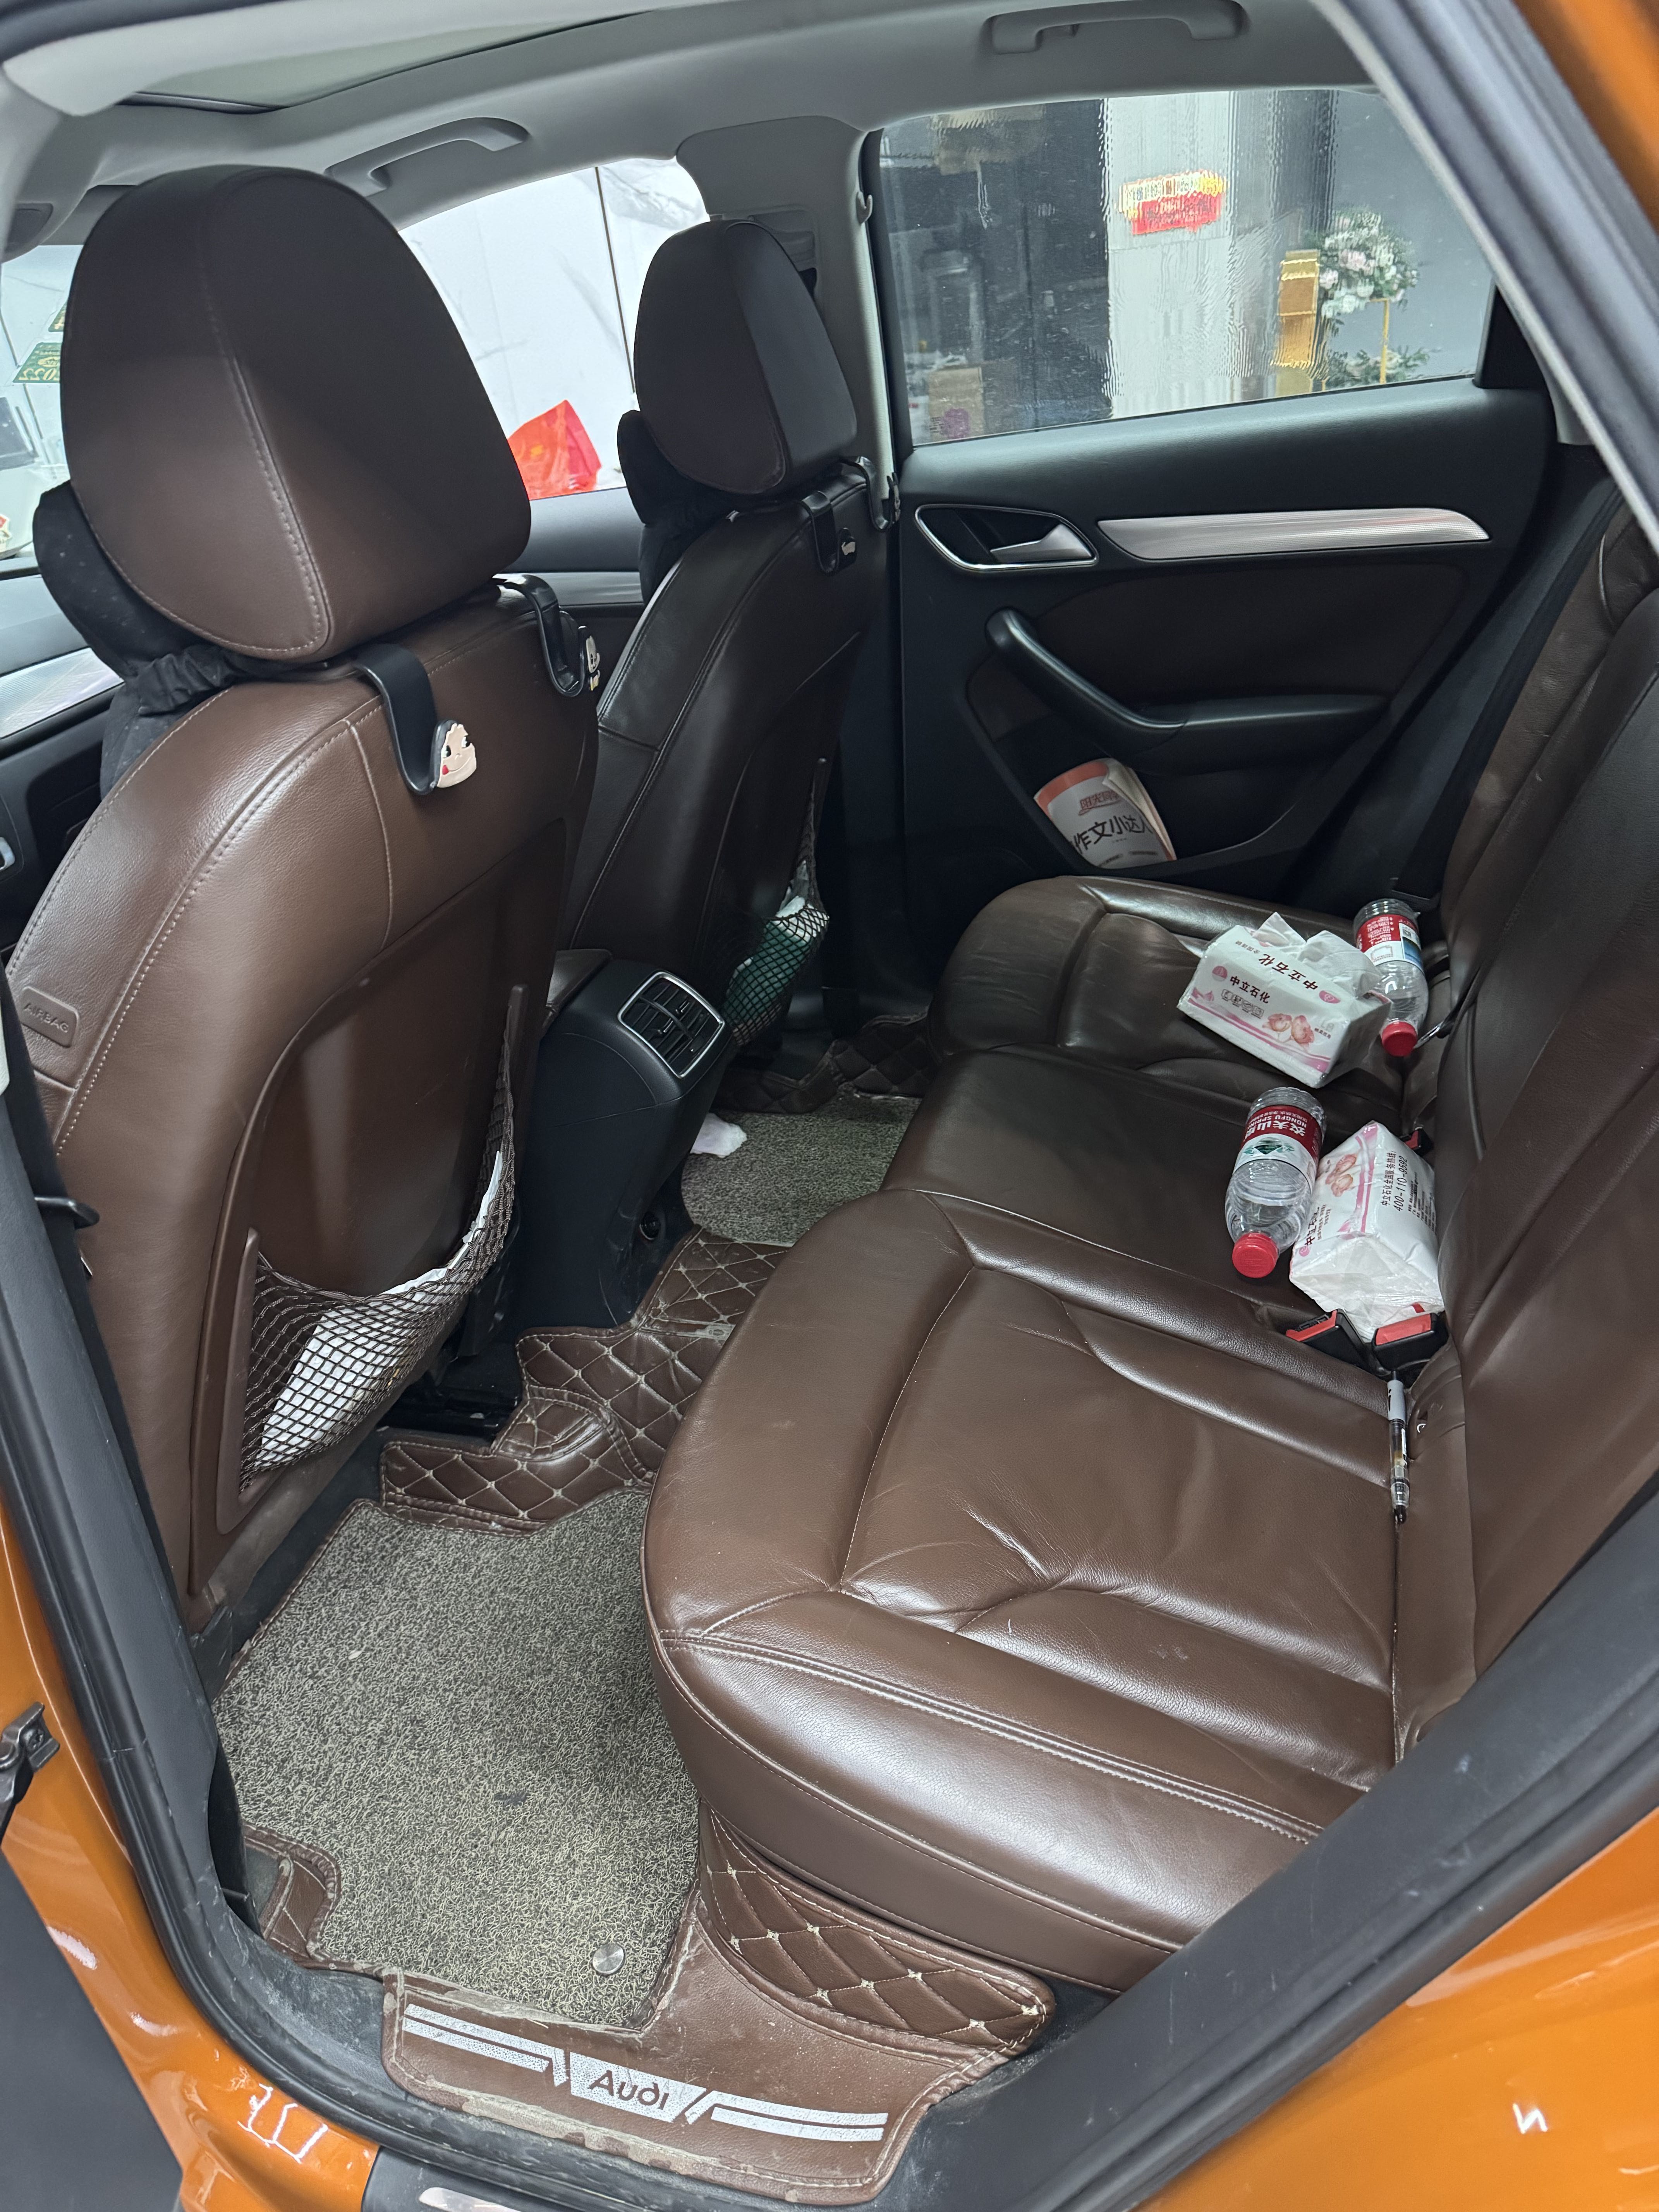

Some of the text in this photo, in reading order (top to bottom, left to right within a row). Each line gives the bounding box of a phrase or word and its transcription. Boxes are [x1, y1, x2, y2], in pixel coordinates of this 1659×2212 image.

[1070, 815, 1154, 854] 作文小达人
[1259, 954, 1318, 990] 中立石化
[1230, 976, 1270, 1004] 中立石化
[24, 1003, 69, 1033] AIRBAG
[1243, 1120, 1305, 1140] 农夫山泉
[1275, 1115, 1307, 1128] NONGFU
[1393, 1156, 1407, 1211] 400-110-9592
[587, 2070, 669, 2110] Audi
